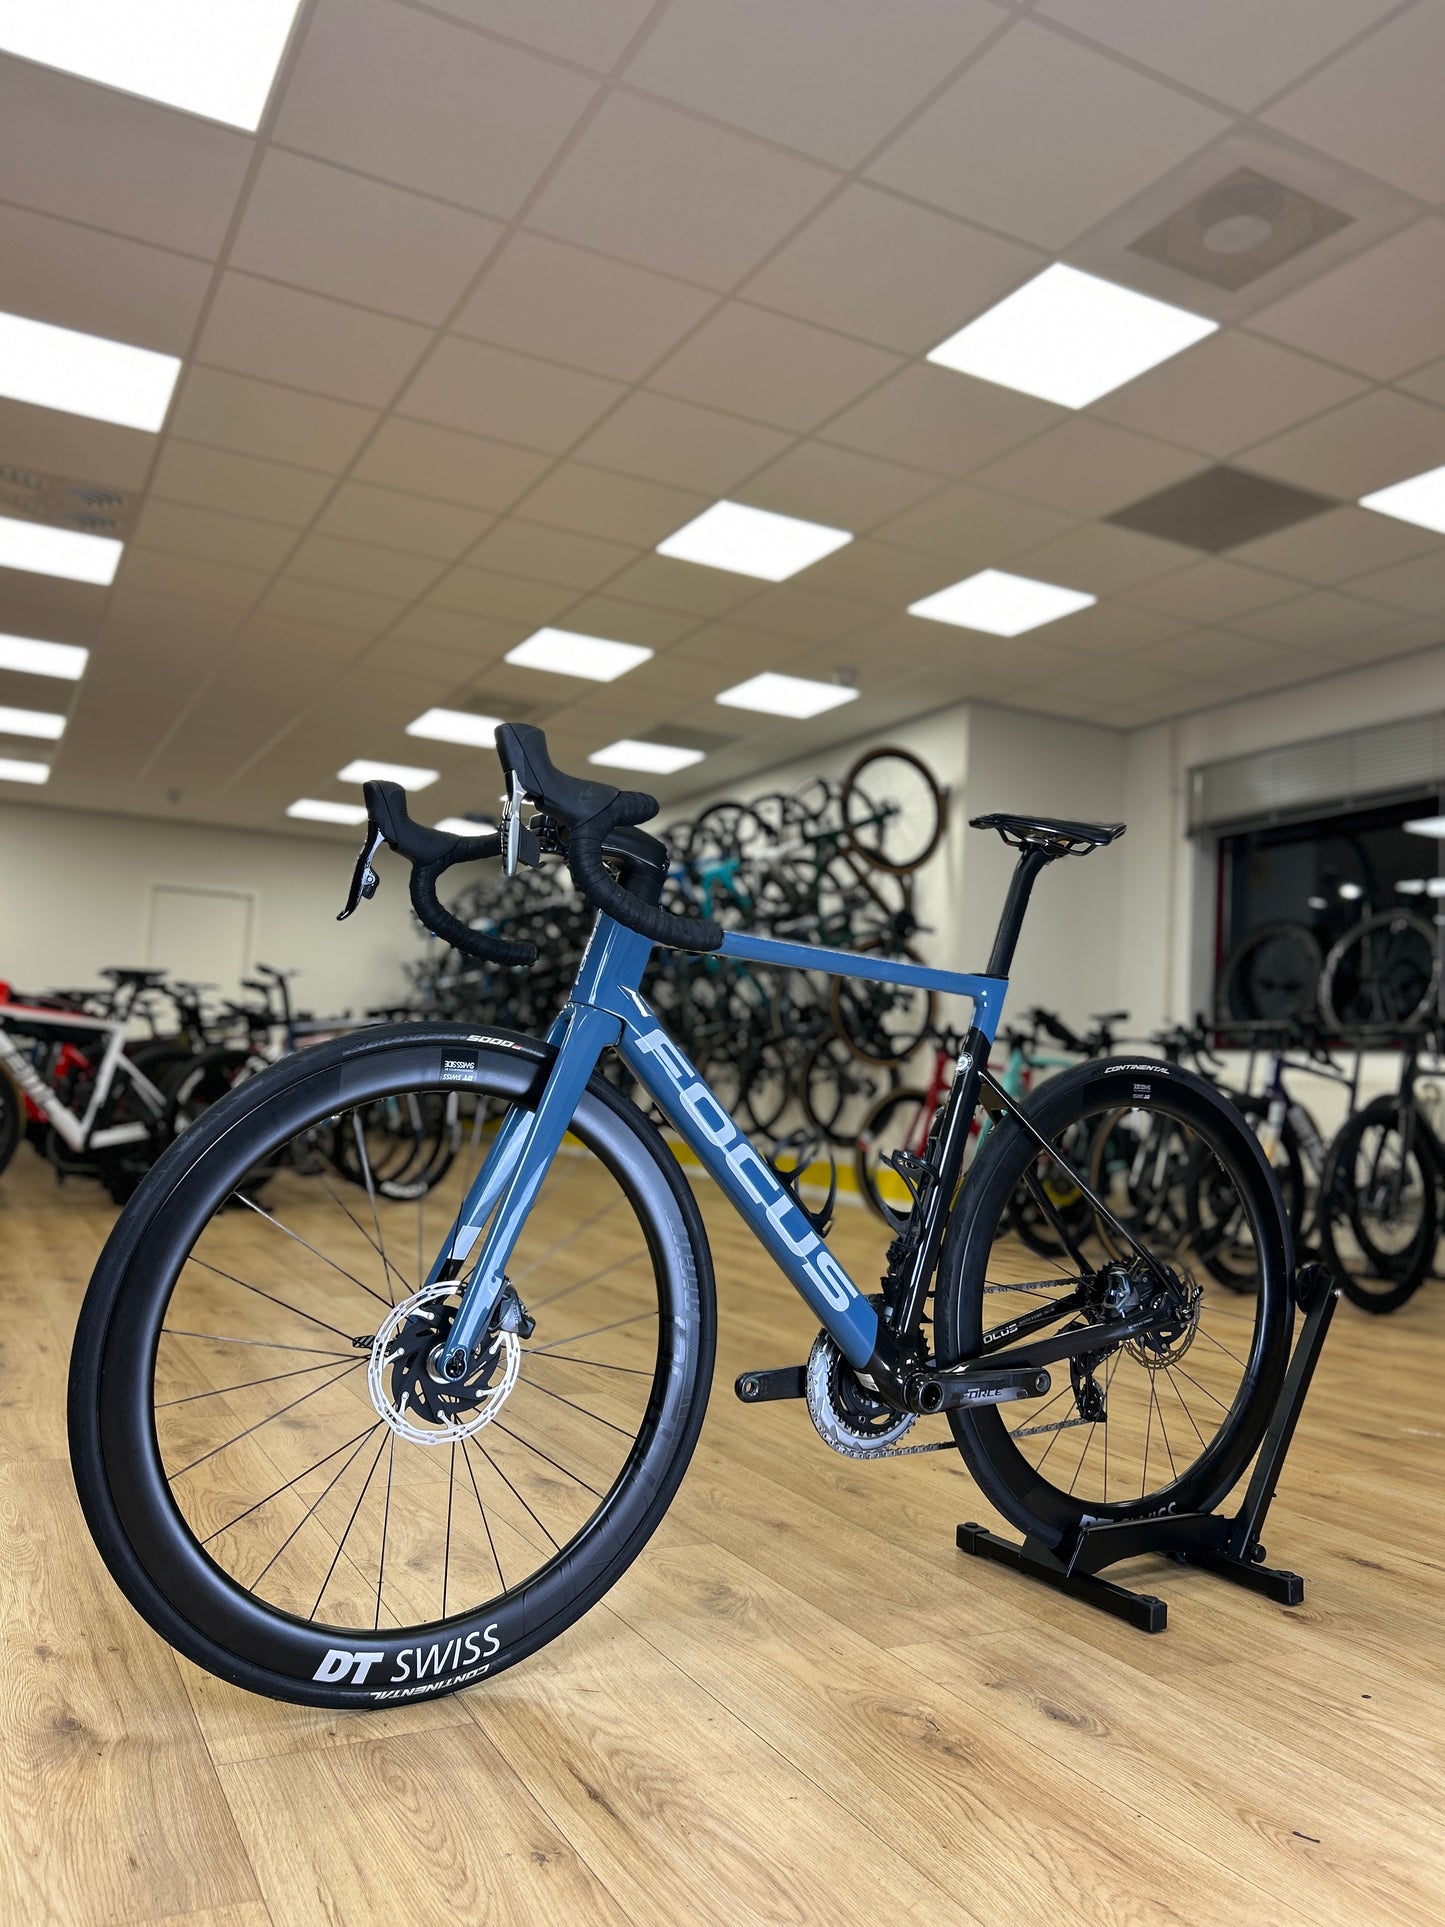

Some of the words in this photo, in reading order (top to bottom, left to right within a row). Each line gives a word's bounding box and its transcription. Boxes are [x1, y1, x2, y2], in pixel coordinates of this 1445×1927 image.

[466, 1034, 515, 1049] 5000
[442, 1073, 463, 1081] SWISS
[1104, 1064, 1170, 1075] CONTINENTAL
[634, 1028, 859, 1313] FOCUS
[983, 1323, 1019, 1345] OCUS
[963, 1388, 1003, 1399] FORCE
[312, 1649, 385, 1685] DT
[390, 1623, 501, 1683] SWISS
[370, 1664, 490, 1701] CONTINENTAL
